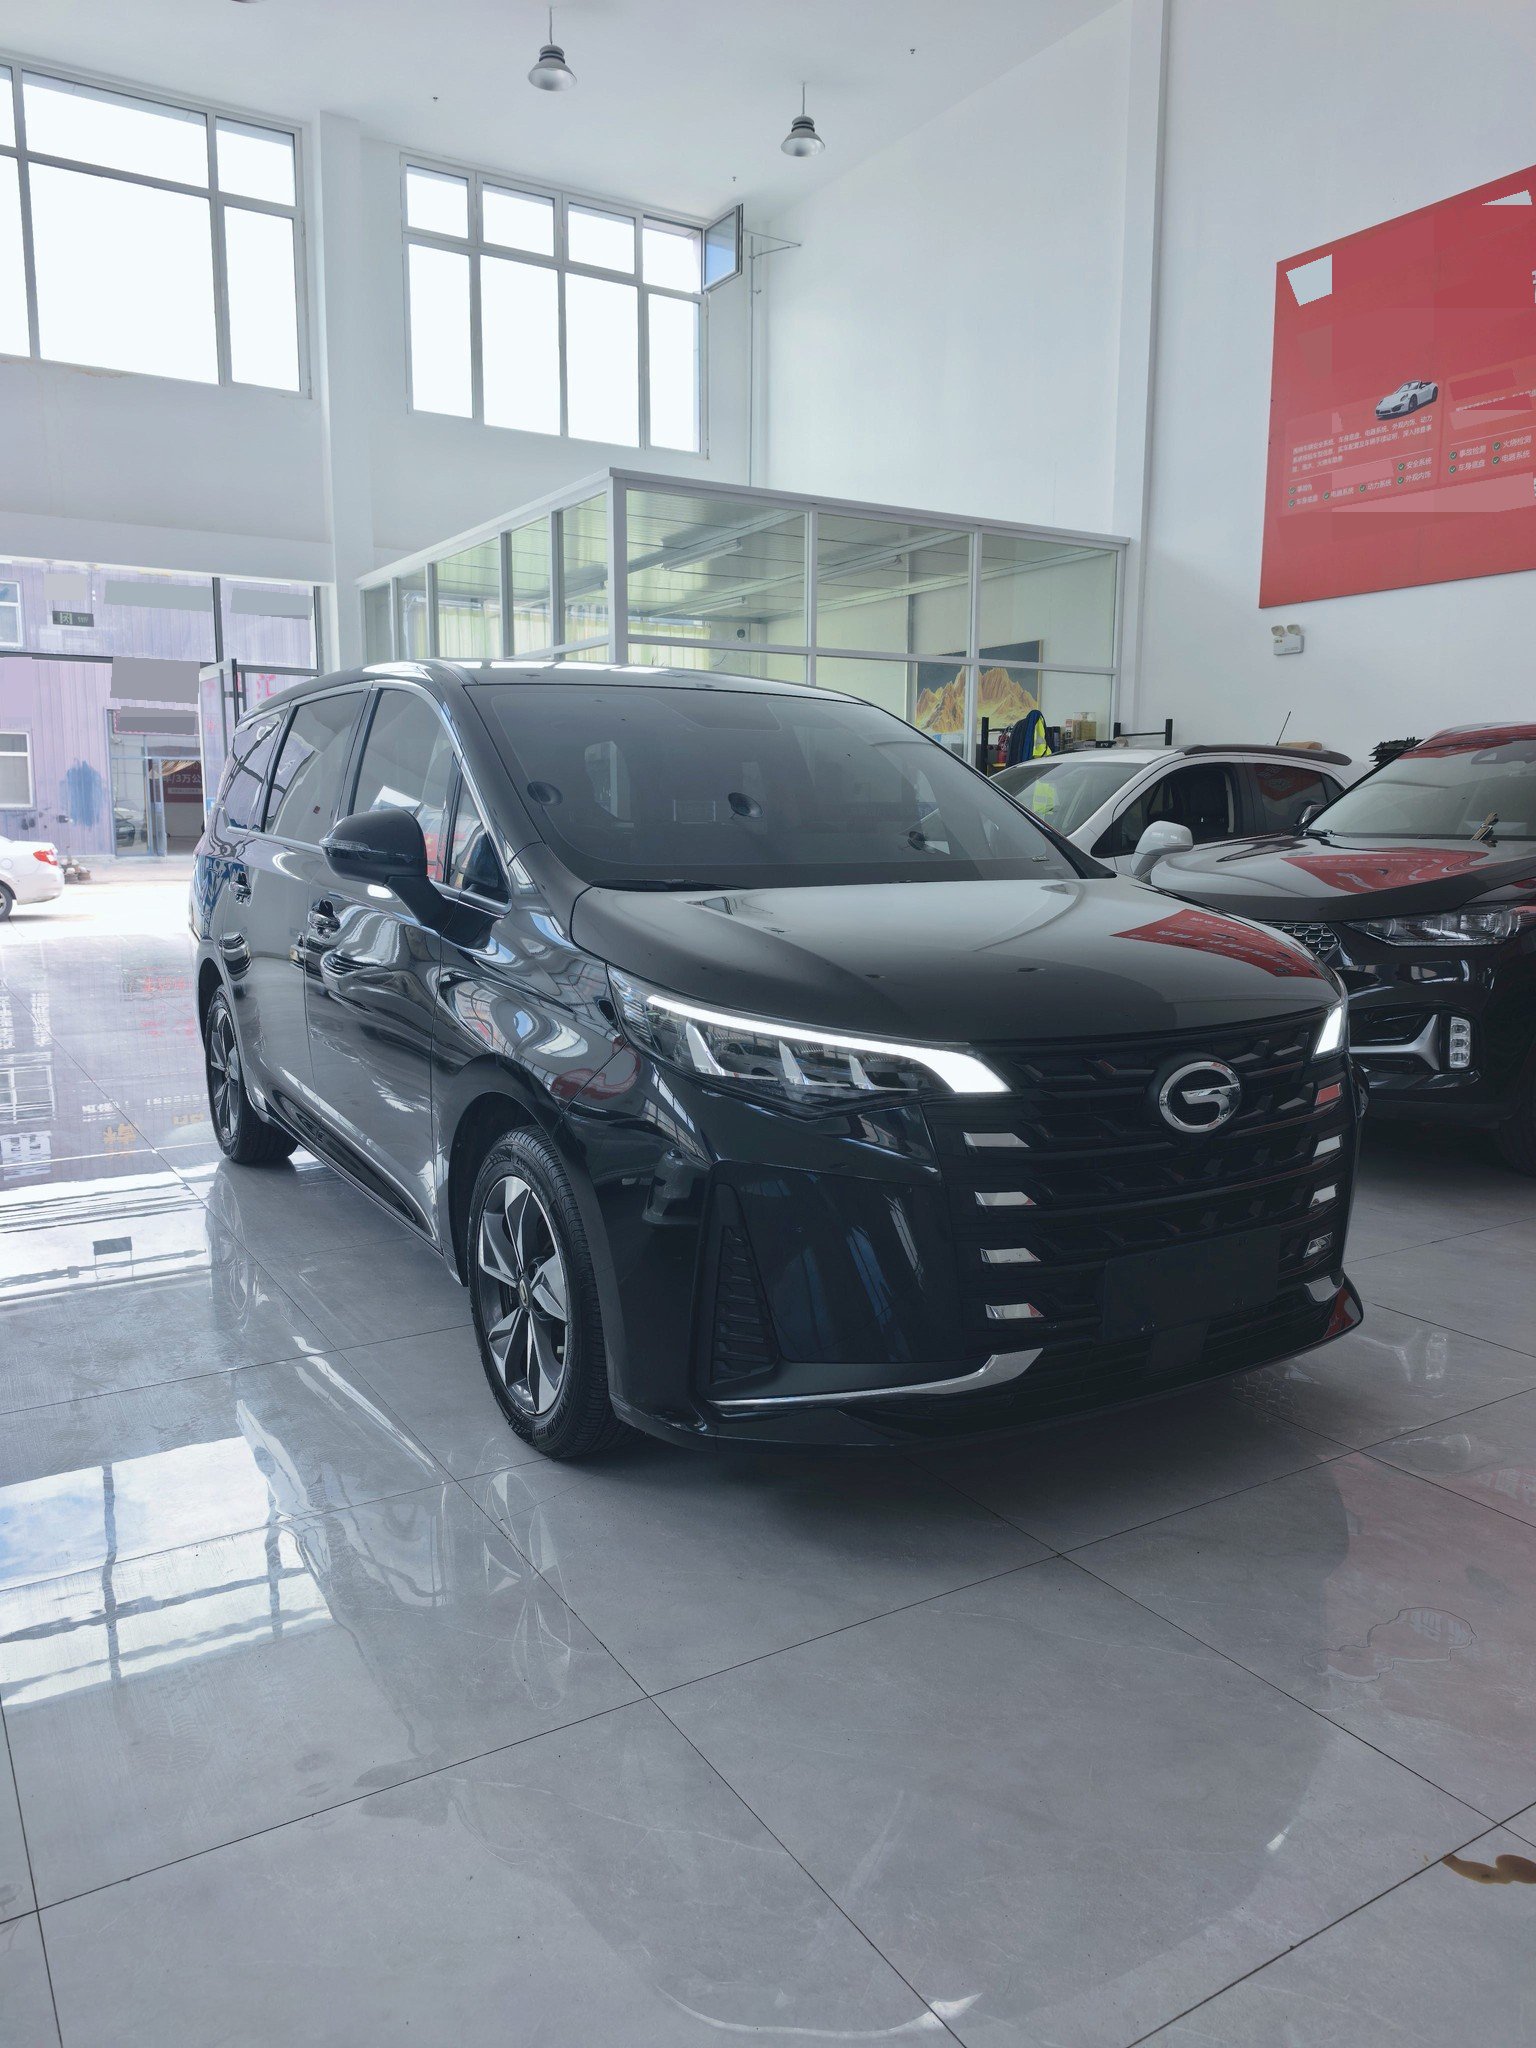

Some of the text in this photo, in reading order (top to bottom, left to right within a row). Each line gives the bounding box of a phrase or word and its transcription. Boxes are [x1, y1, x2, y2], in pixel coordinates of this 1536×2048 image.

[1406, 457, 1432, 469] 安全系统
[1405, 470, 1432, 483] 外观内饰
